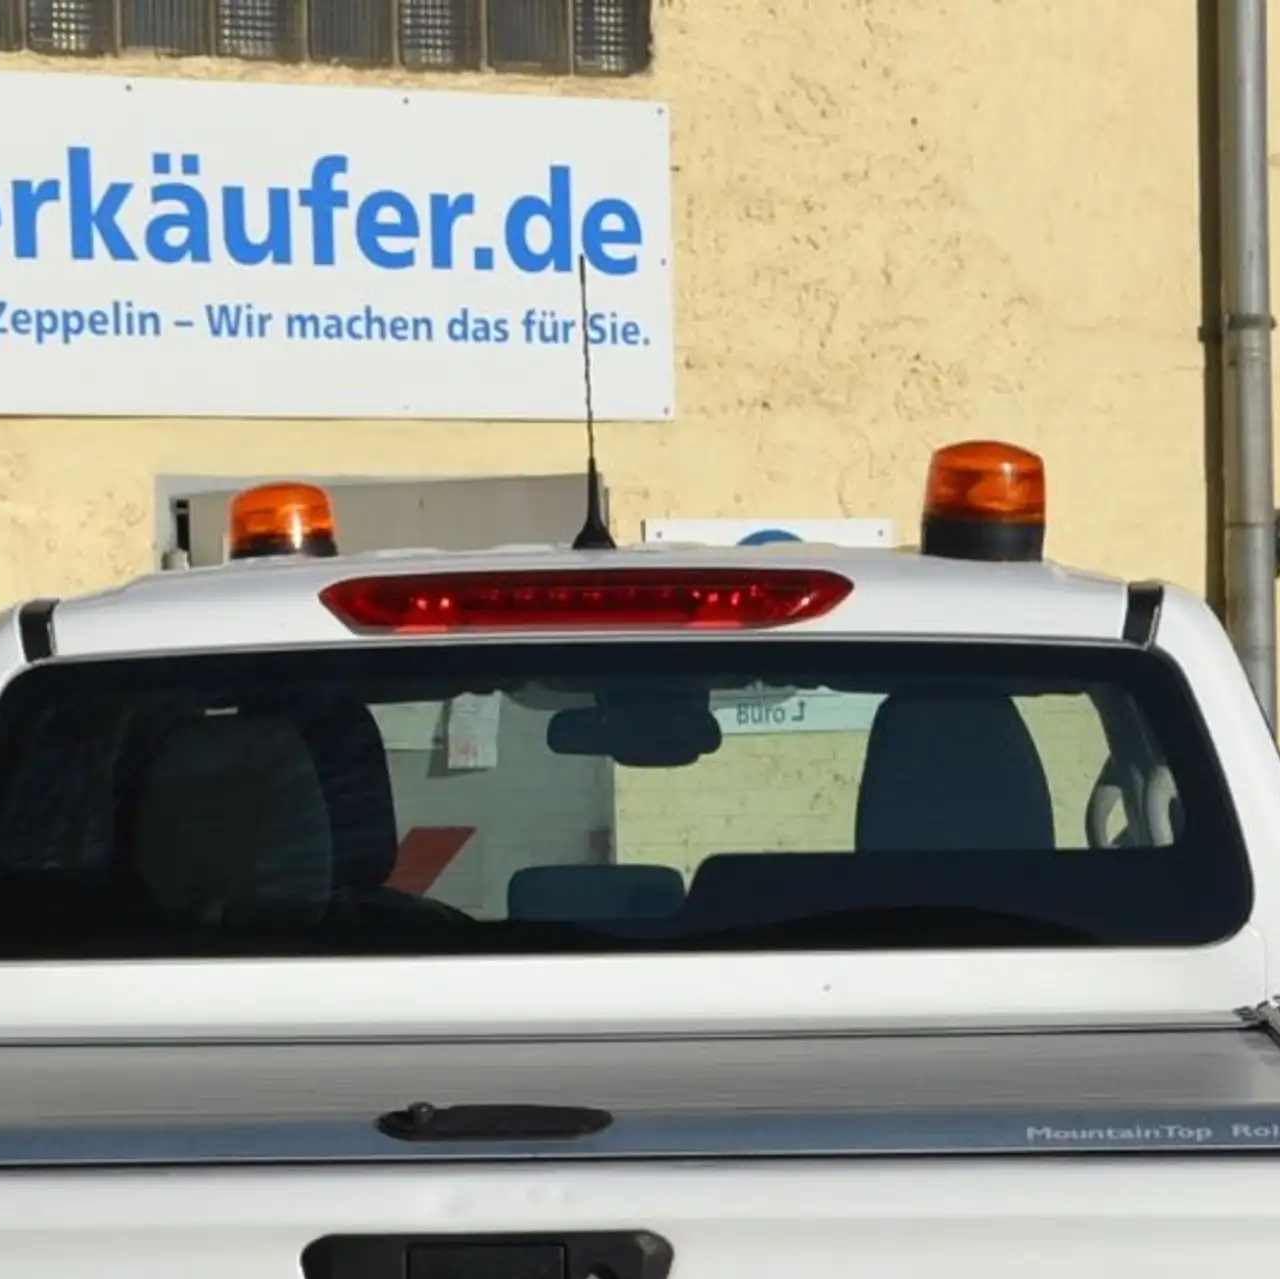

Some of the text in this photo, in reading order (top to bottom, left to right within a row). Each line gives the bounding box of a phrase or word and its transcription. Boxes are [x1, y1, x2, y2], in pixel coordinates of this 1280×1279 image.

[204, 304, 274, 339] Wir
[285, 307, 434, 343] machen
[446, 308, 510, 344] das
[522, 308, 577, 345] für
[587, 312, 652, 346] Sie.
[1025, 1123, 1214, 1143] MountainTop
